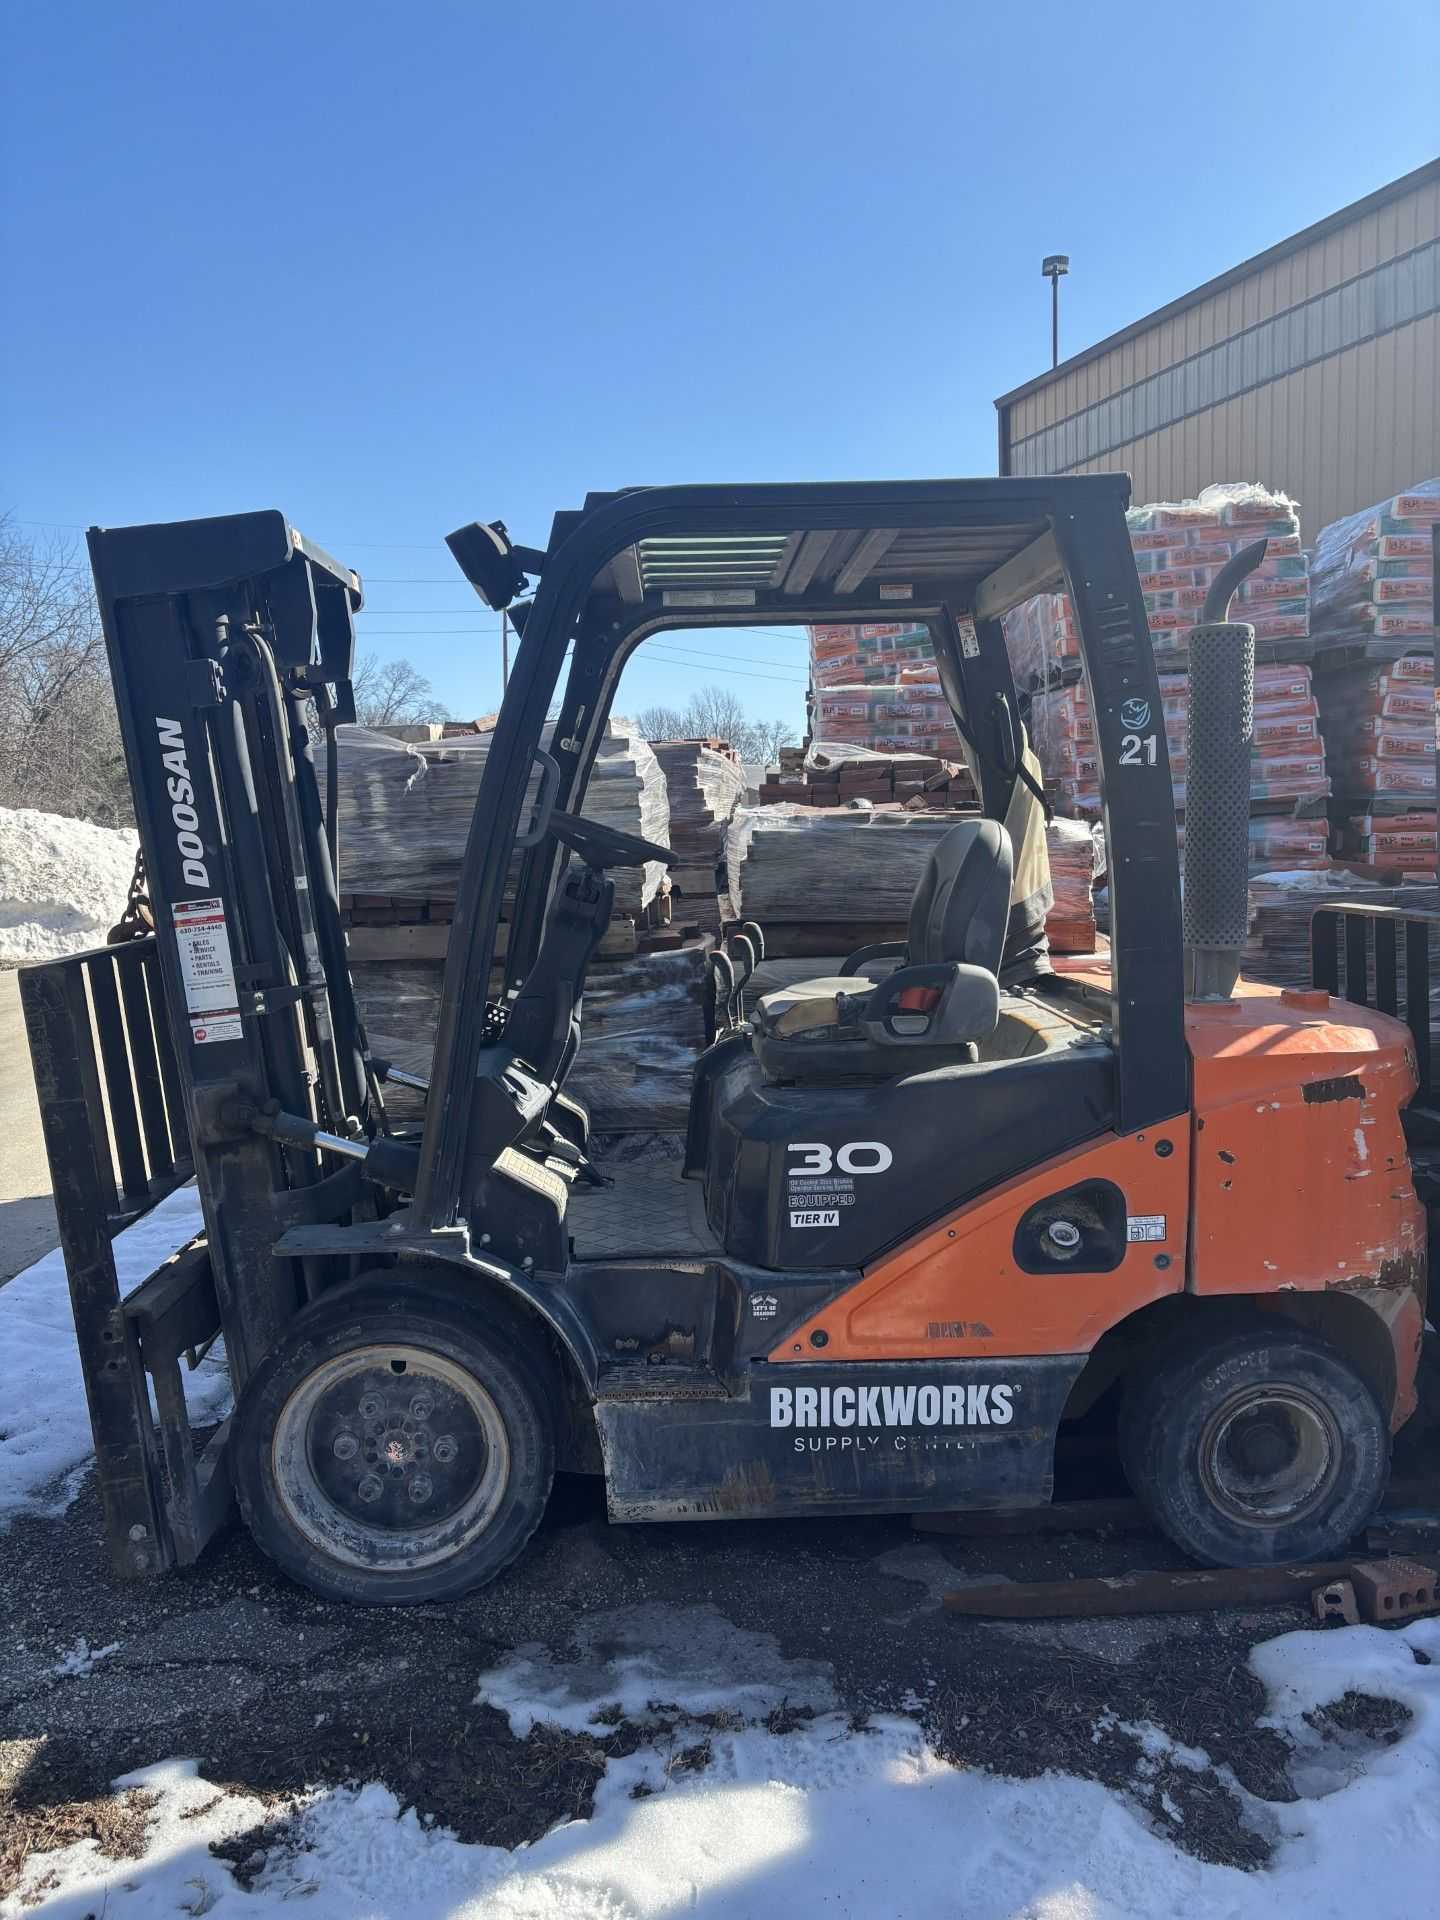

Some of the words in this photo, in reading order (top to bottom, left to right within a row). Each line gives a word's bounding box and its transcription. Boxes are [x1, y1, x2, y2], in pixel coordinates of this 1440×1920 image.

[1119, 734, 1157, 766] 21
[155, 717, 209, 888] DOOSAN
[787, 1141, 893, 1176] 30
[788, 1193, 855, 1208] EQUIPPED
[794, 1213, 821, 1225] TIER
[823, 1212, 836, 1224] IV
[794, 1436, 880, 1452] SUPPLY
